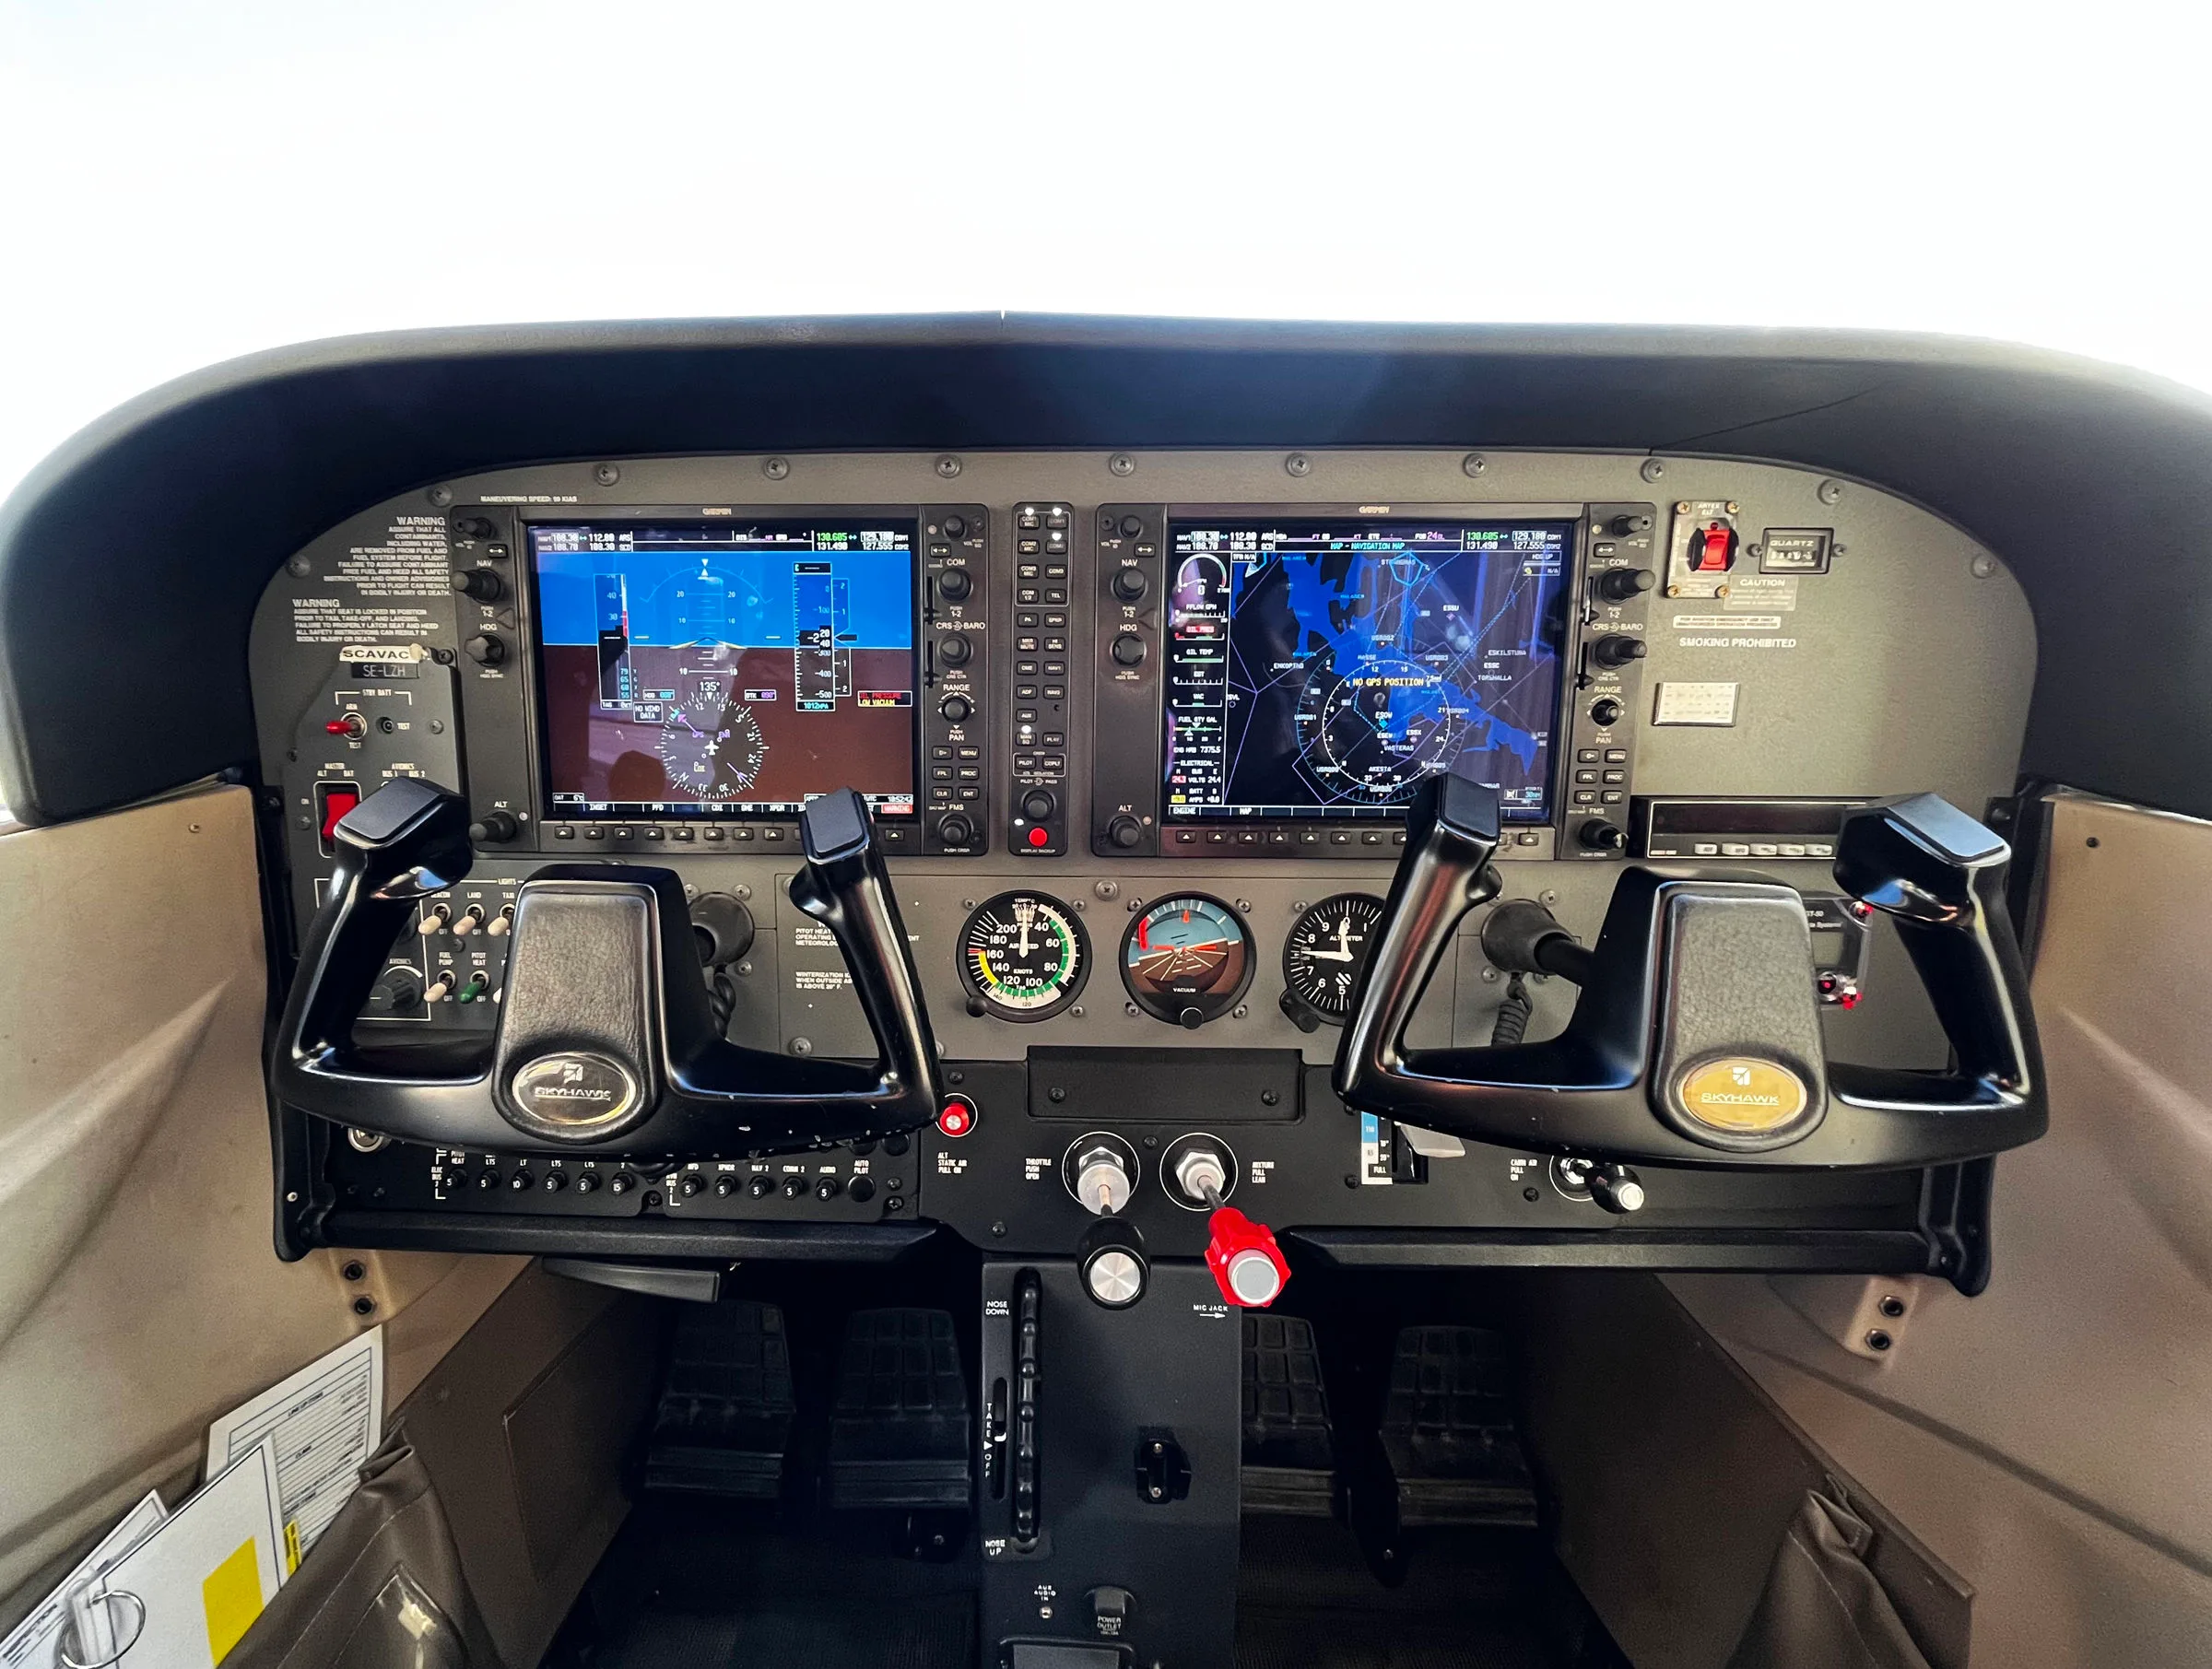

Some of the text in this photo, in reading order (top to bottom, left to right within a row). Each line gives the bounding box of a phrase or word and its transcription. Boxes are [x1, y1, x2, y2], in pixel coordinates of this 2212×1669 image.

[1359, 506, 1390, 514] GARMIN
[396, 516, 445, 526] WARNING
[1351, 542, 1406, 550] NAVIGATION MAP
[947, 558, 966, 567] COM
[1608, 558, 1629, 567] COM
[677, 590, 685, 598] 20
[292, 599, 340, 608] WARNING
[479, 623, 498, 631] HDG
[1119, 624, 1138, 632] HDG
[1592, 623, 1609, 631] CRS
[1679, 638, 1796, 648] SMOKING PROHIBITED
[342, 649, 409, 660] SCAVAC
[362, 664, 406, 678] SE-LZH
[700, 682, 721, 691] 135°
[1352, 677, 1424, 687] NO GPS POSITION
[948, 734, 965, 742] PAN
[995, 923, 1018, 934] 200
[1034, 922, 1049, 932] 40
[1322, 922, 1330, 932] 9
[989, 934, 1007, 945] 180
[1045, 938, 1060, 947] 60
[1308, 934, 1315, 944] 8
[986, 949, 1004, 959] 160
[993, 962, 1010, 972] 140
[1043, 962, 1058, 972] 80
[1307, 966, 1314, 975] 7
[1003, 975, 1020, 985] 120
[1026, 978, 1043, 987] 100
[1318, 978, 1326, 988] 6
[1338, 986, 1346, 994] 5
[534, 1087, 612, 1099] SKYHAWK
[1700, 1092, 1780, 1103] SKYHAWK
[1511, 1158, 1537, 1167] CABIN AIR
[938, 1166, 951, 1174] PULL
[1373, 1166, 1387, 1174] FULL
[446, 1178, 453, 1186] 5
[480, 1180, 487, 1188] 5
[512, 1180, 521, 1189] 10
[547, 1181, 553, 1190] 5
[580, 1182, 586, 1192] 5
[613, 1182, 621, 1192] 15
[685, 1185, 691, 1194] 5
[719, 1186, 725, 1194] 5
[753, 1186, 759, 1195] 5
[786, 1187, 793, 1196] 5
[821, 1188, 827, 1197] 5
[986, 1300, 1007, 1309] NOSE
[985, 1308, 1009, 1316] DOWN
[985, 1539, 1006, 1547] NOSE
[989, 1547, 1002, 1556] UP
